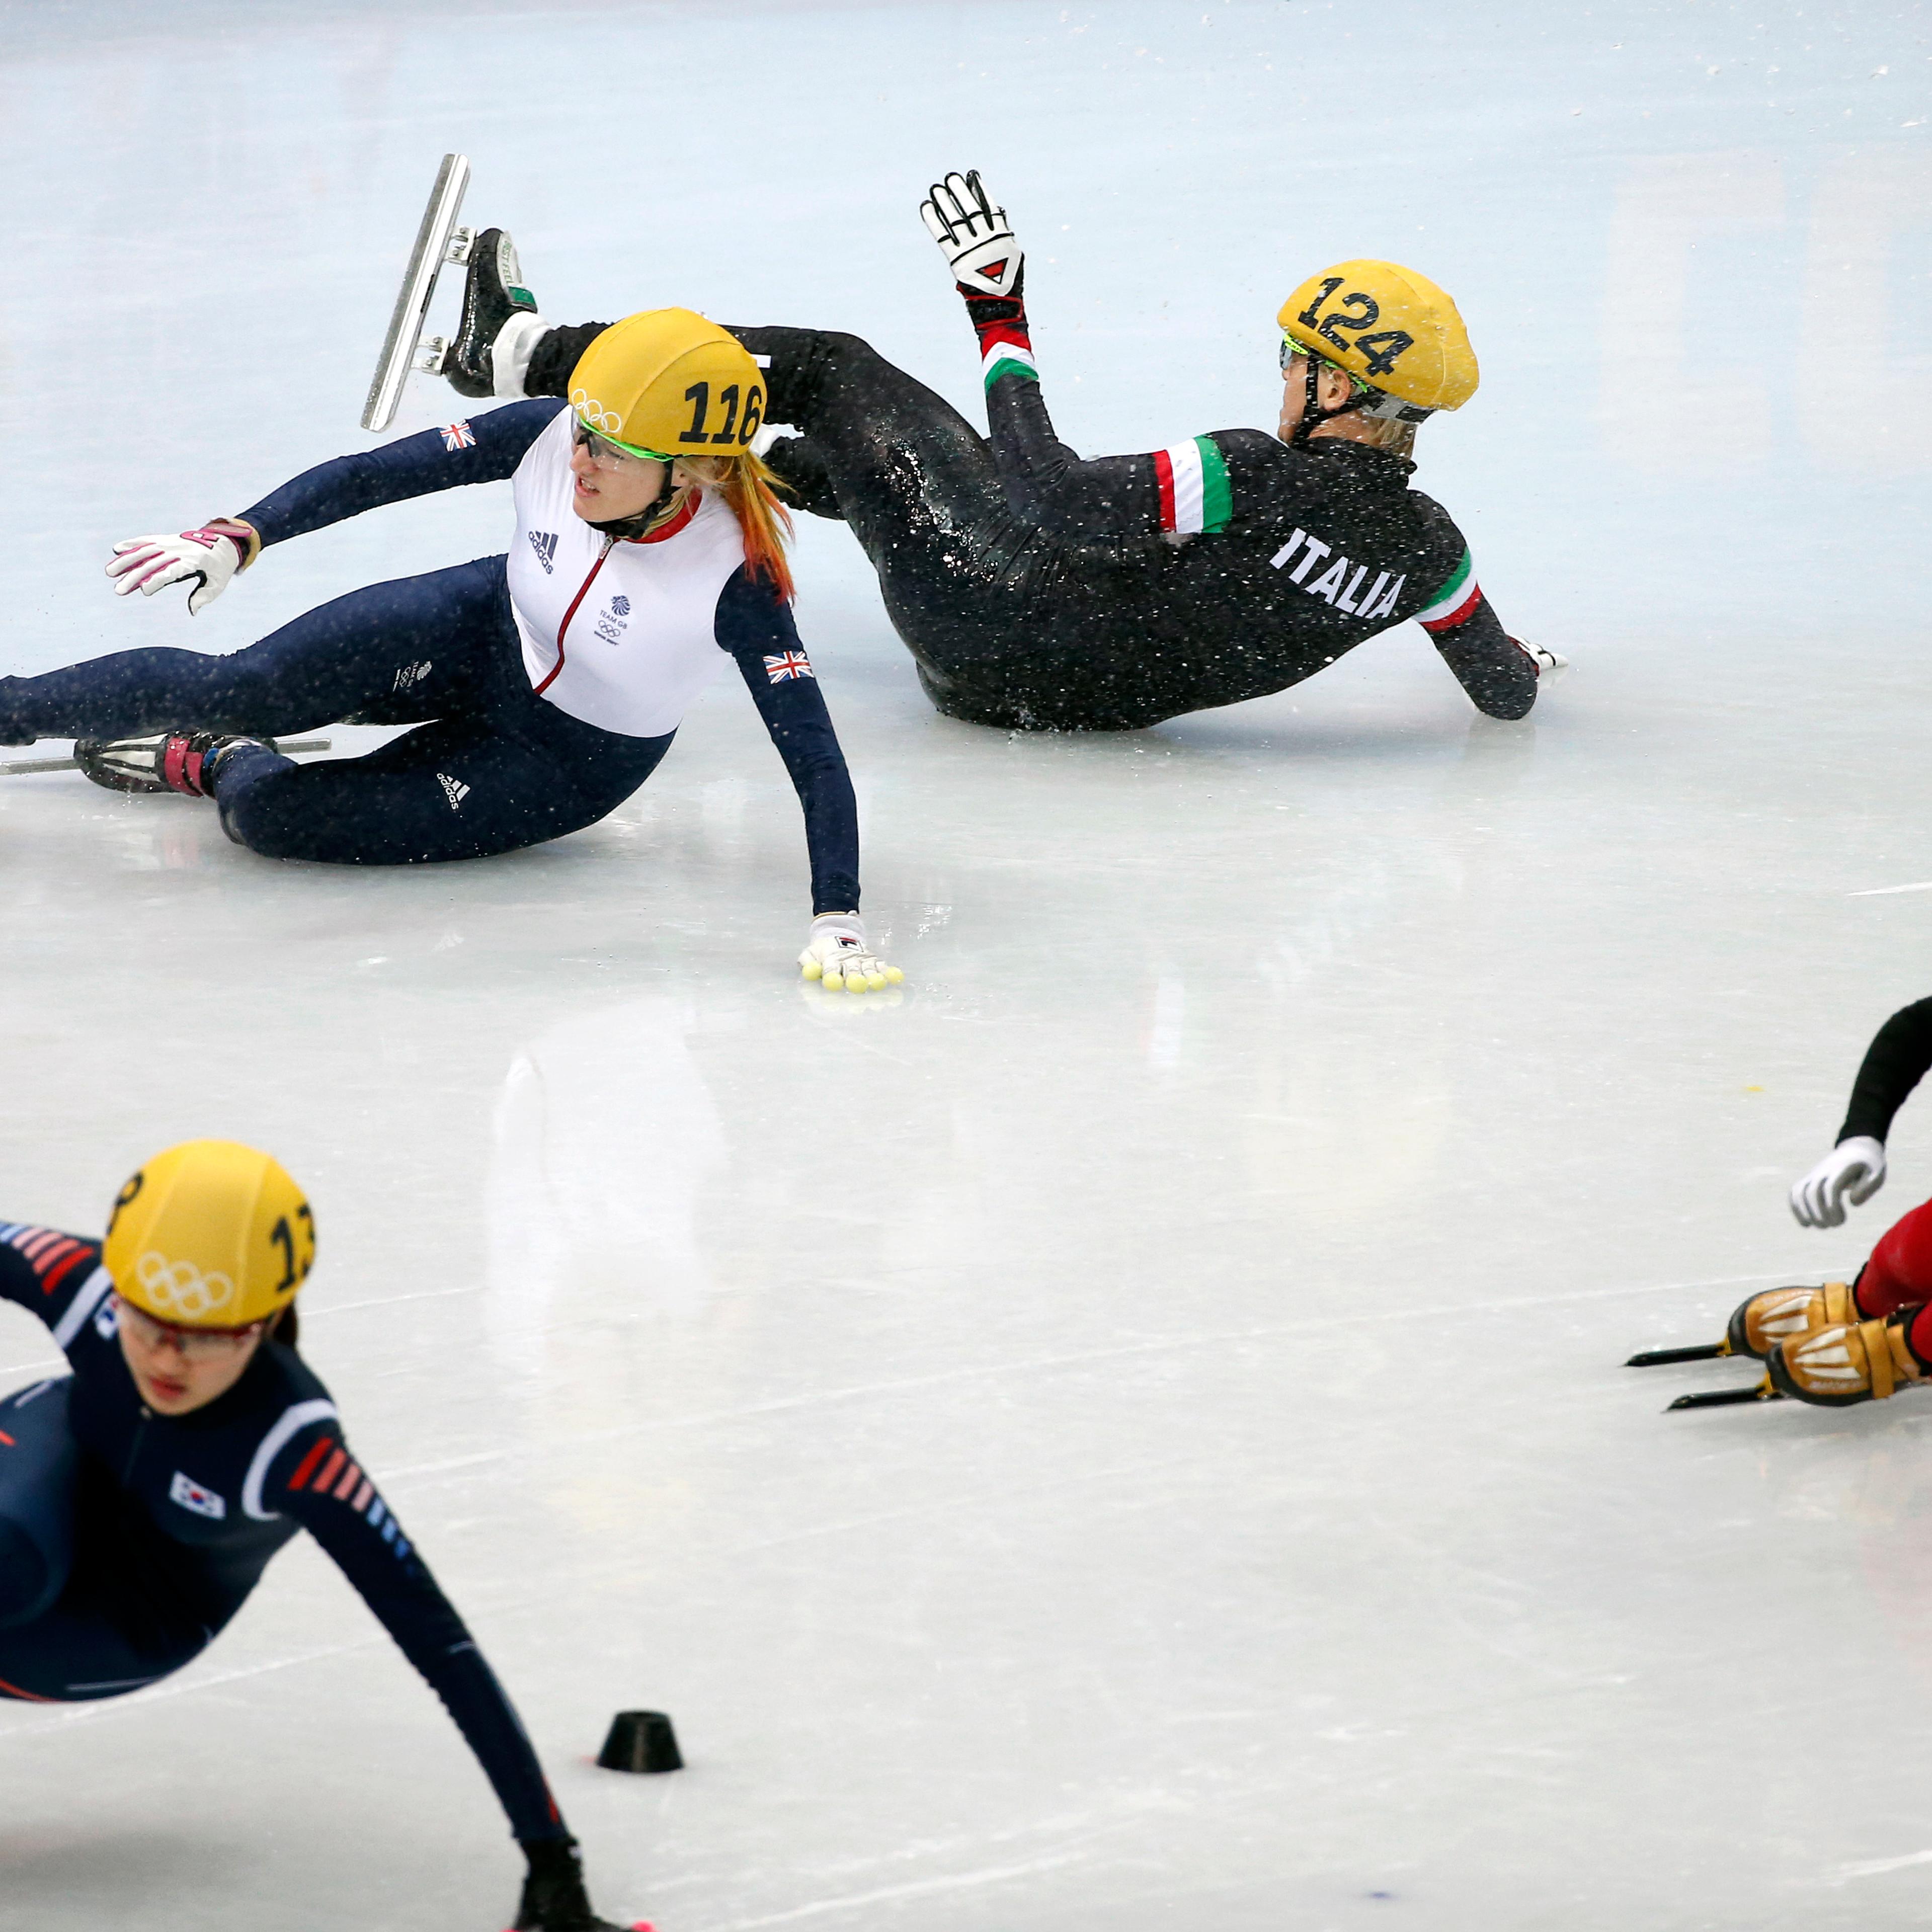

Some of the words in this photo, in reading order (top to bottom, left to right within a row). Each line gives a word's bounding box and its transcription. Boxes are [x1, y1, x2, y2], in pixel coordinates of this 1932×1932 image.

[1298, 277, 1414, 376] 124
[679, 381, 762, 445] 116
[528, 531, 553, 575] adidas
[1269, 527, 1407, 619] ITALIA
[600, 609, 617, 624] TEAM
[618, 621, 627, 629] GB
[436, 773, 459, 810] adidas
